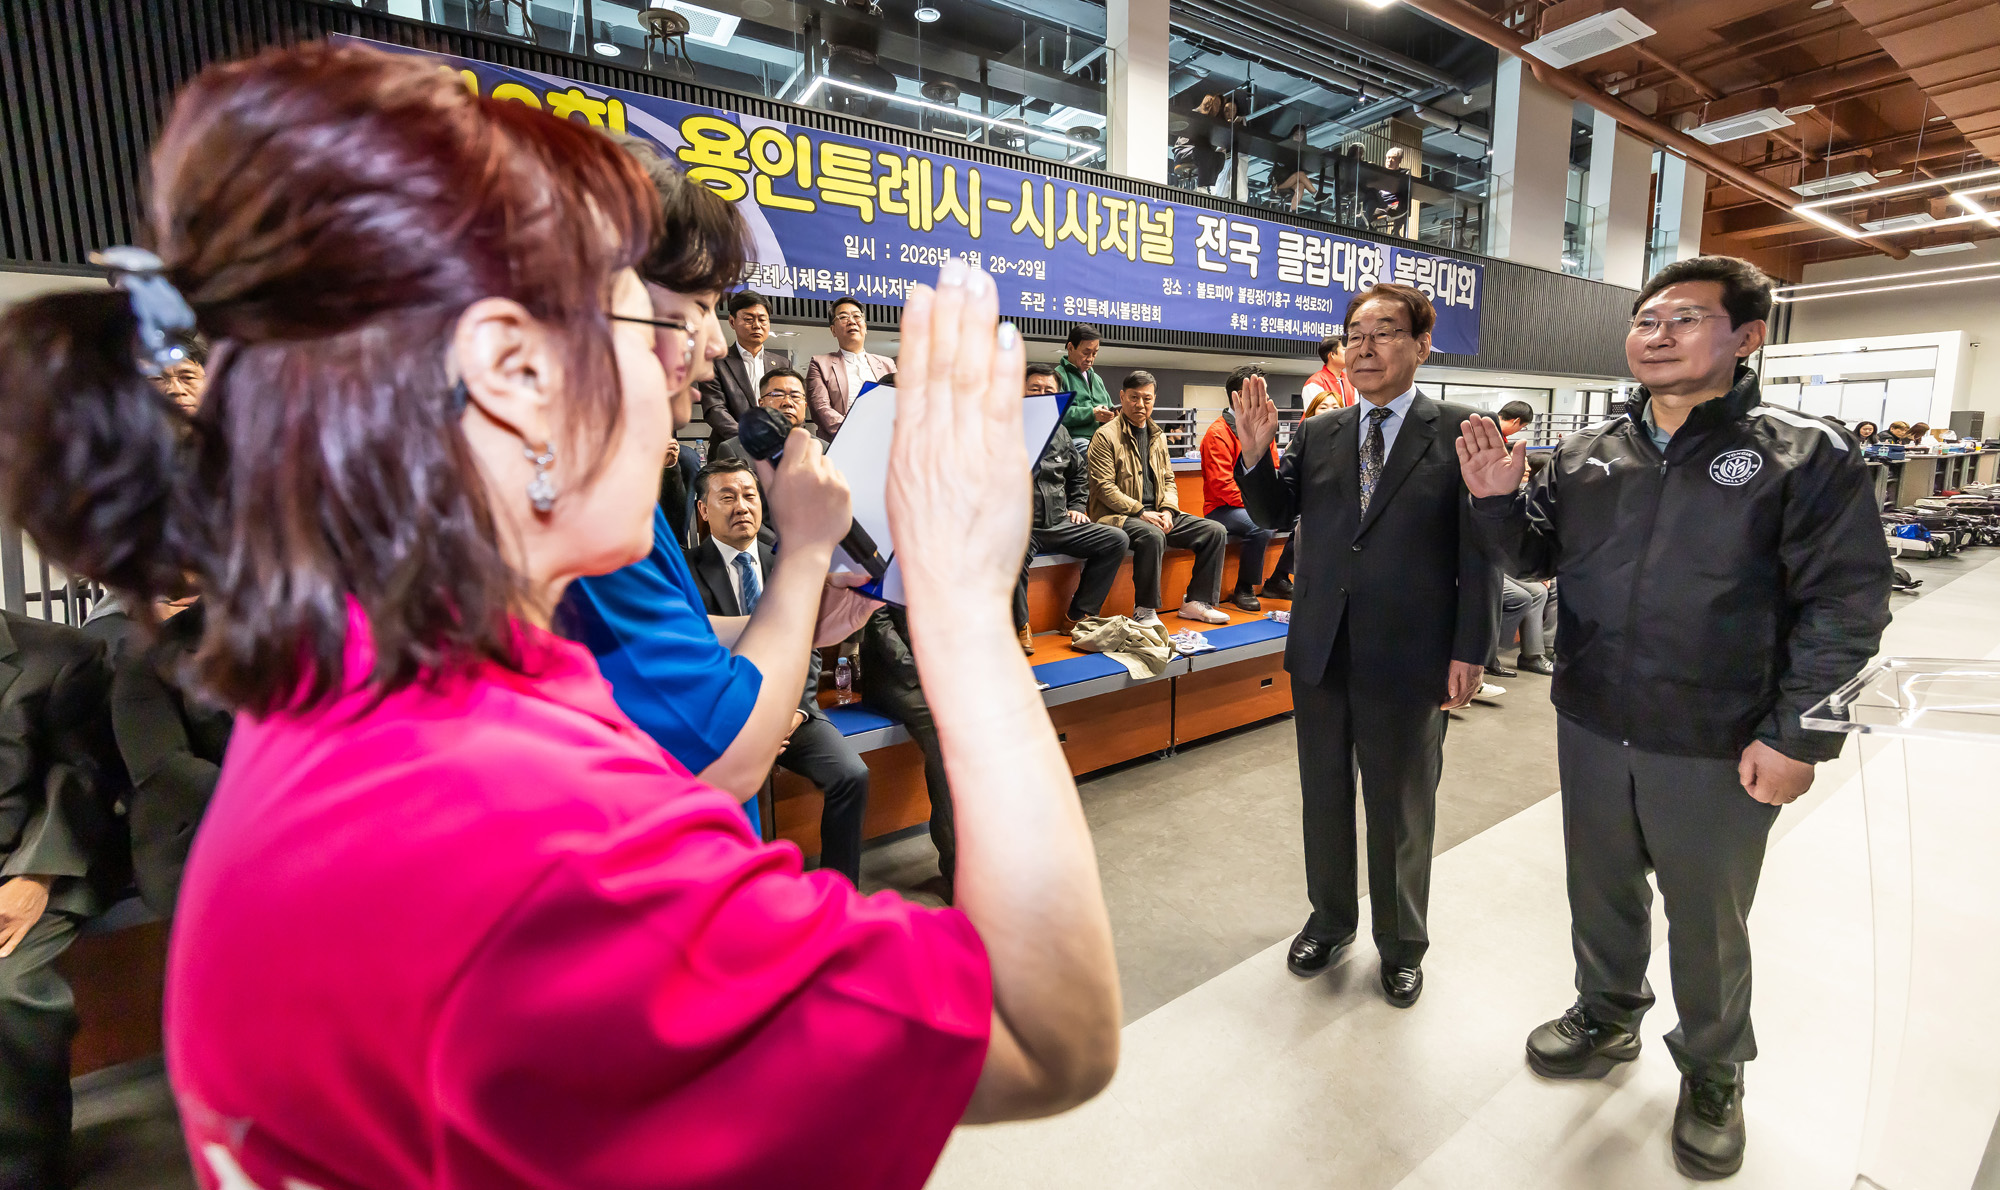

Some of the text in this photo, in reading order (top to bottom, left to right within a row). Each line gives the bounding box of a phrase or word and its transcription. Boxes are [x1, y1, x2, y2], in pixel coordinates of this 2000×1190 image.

[676, 113, 1477, 311] 용인특례시-시사저널 전국 클럽대항 볼링대회
[843, 234, 876, 261] 일시
[900, 243, 951, 268] 2026년
[989, 255, 1046, 281] 28~29일
[738, 261, 917, 300] 특례시체육회,시사저널
[1162, 278, 1183, 296] 장소
[1196, 281, 1234, 303] 볼토피아
[1237, 286, 1292, 309] 볼링장(기흥구
[1294, 294, 1334, 314] 석성로521)
[1020, 291, 1046, 313] 주관
[1063, 295, 1162, 324] 용인특례시볼링협회
[1229, 313, 1248, 331] 후원
